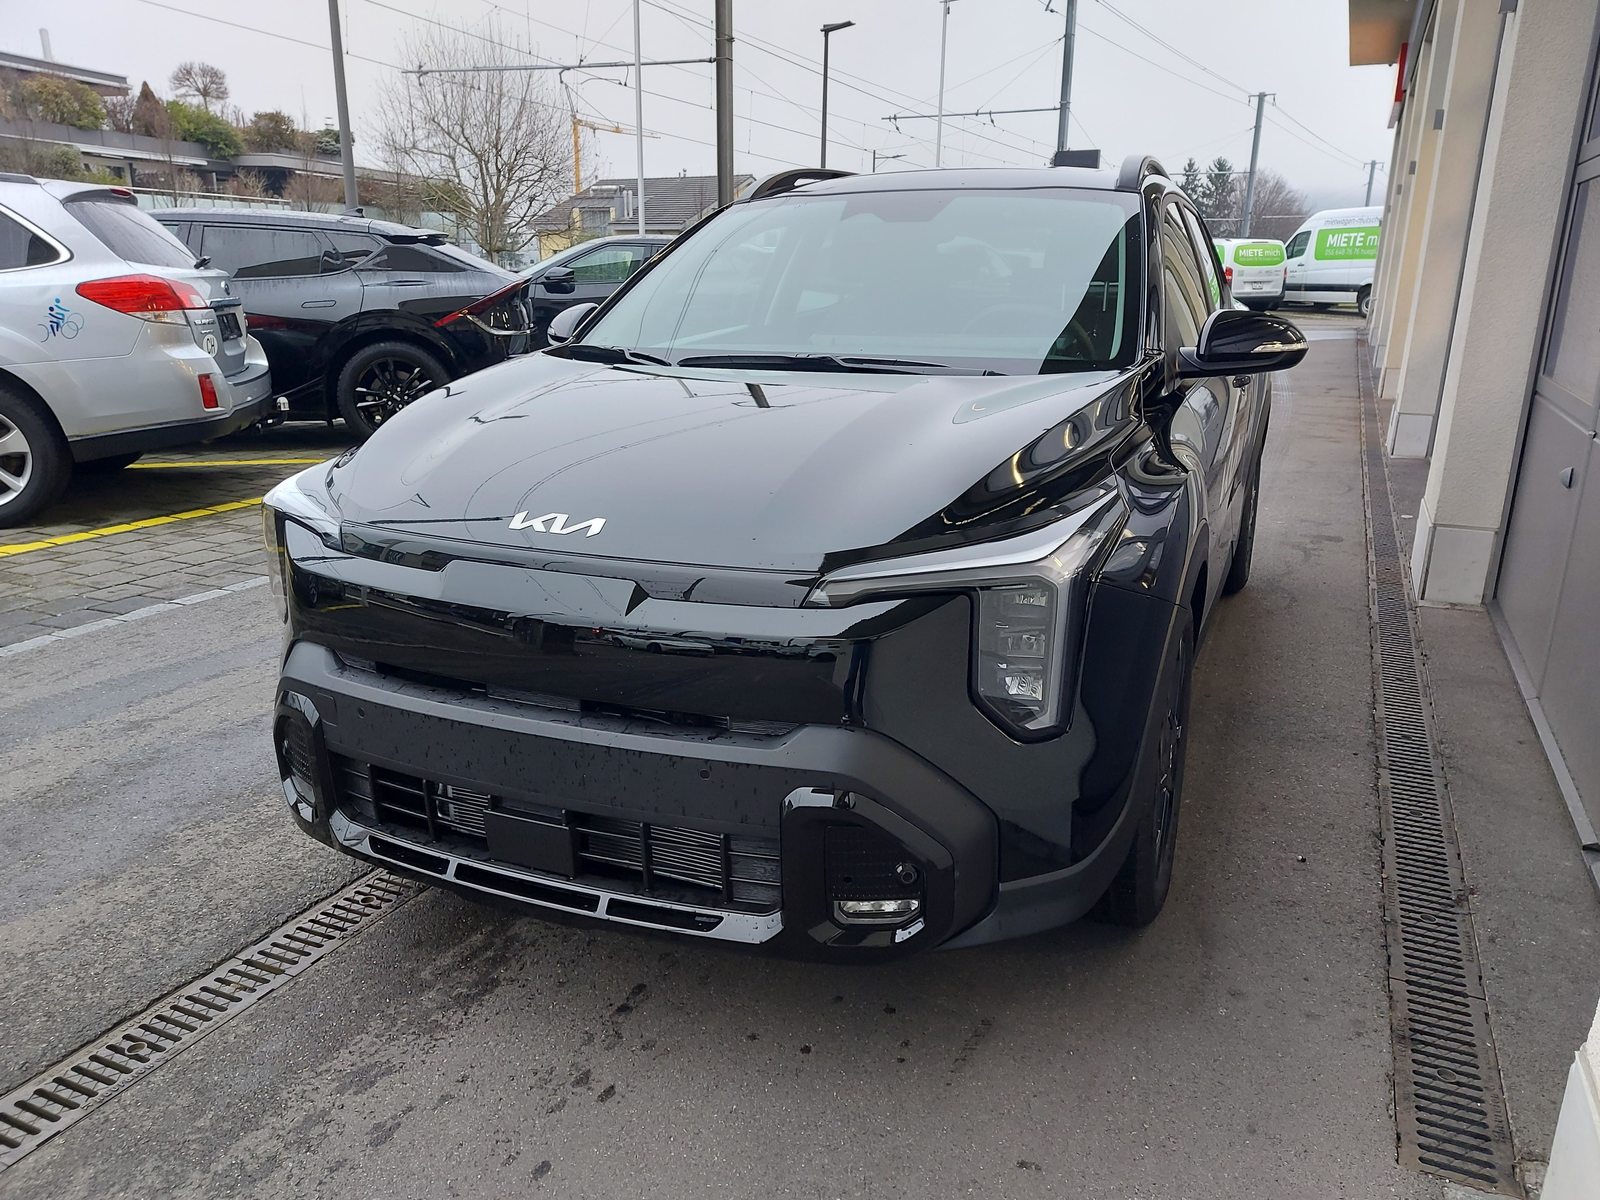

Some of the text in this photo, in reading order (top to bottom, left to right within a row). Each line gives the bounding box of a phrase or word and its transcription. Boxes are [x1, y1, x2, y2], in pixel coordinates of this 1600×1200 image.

[1326, 232, 1378, 247] MIETE m
[1239, 248, 1281, 257] MIETE mich
[206, 337, 216, 355] CH
[508, 510, 607, 538] KIA
